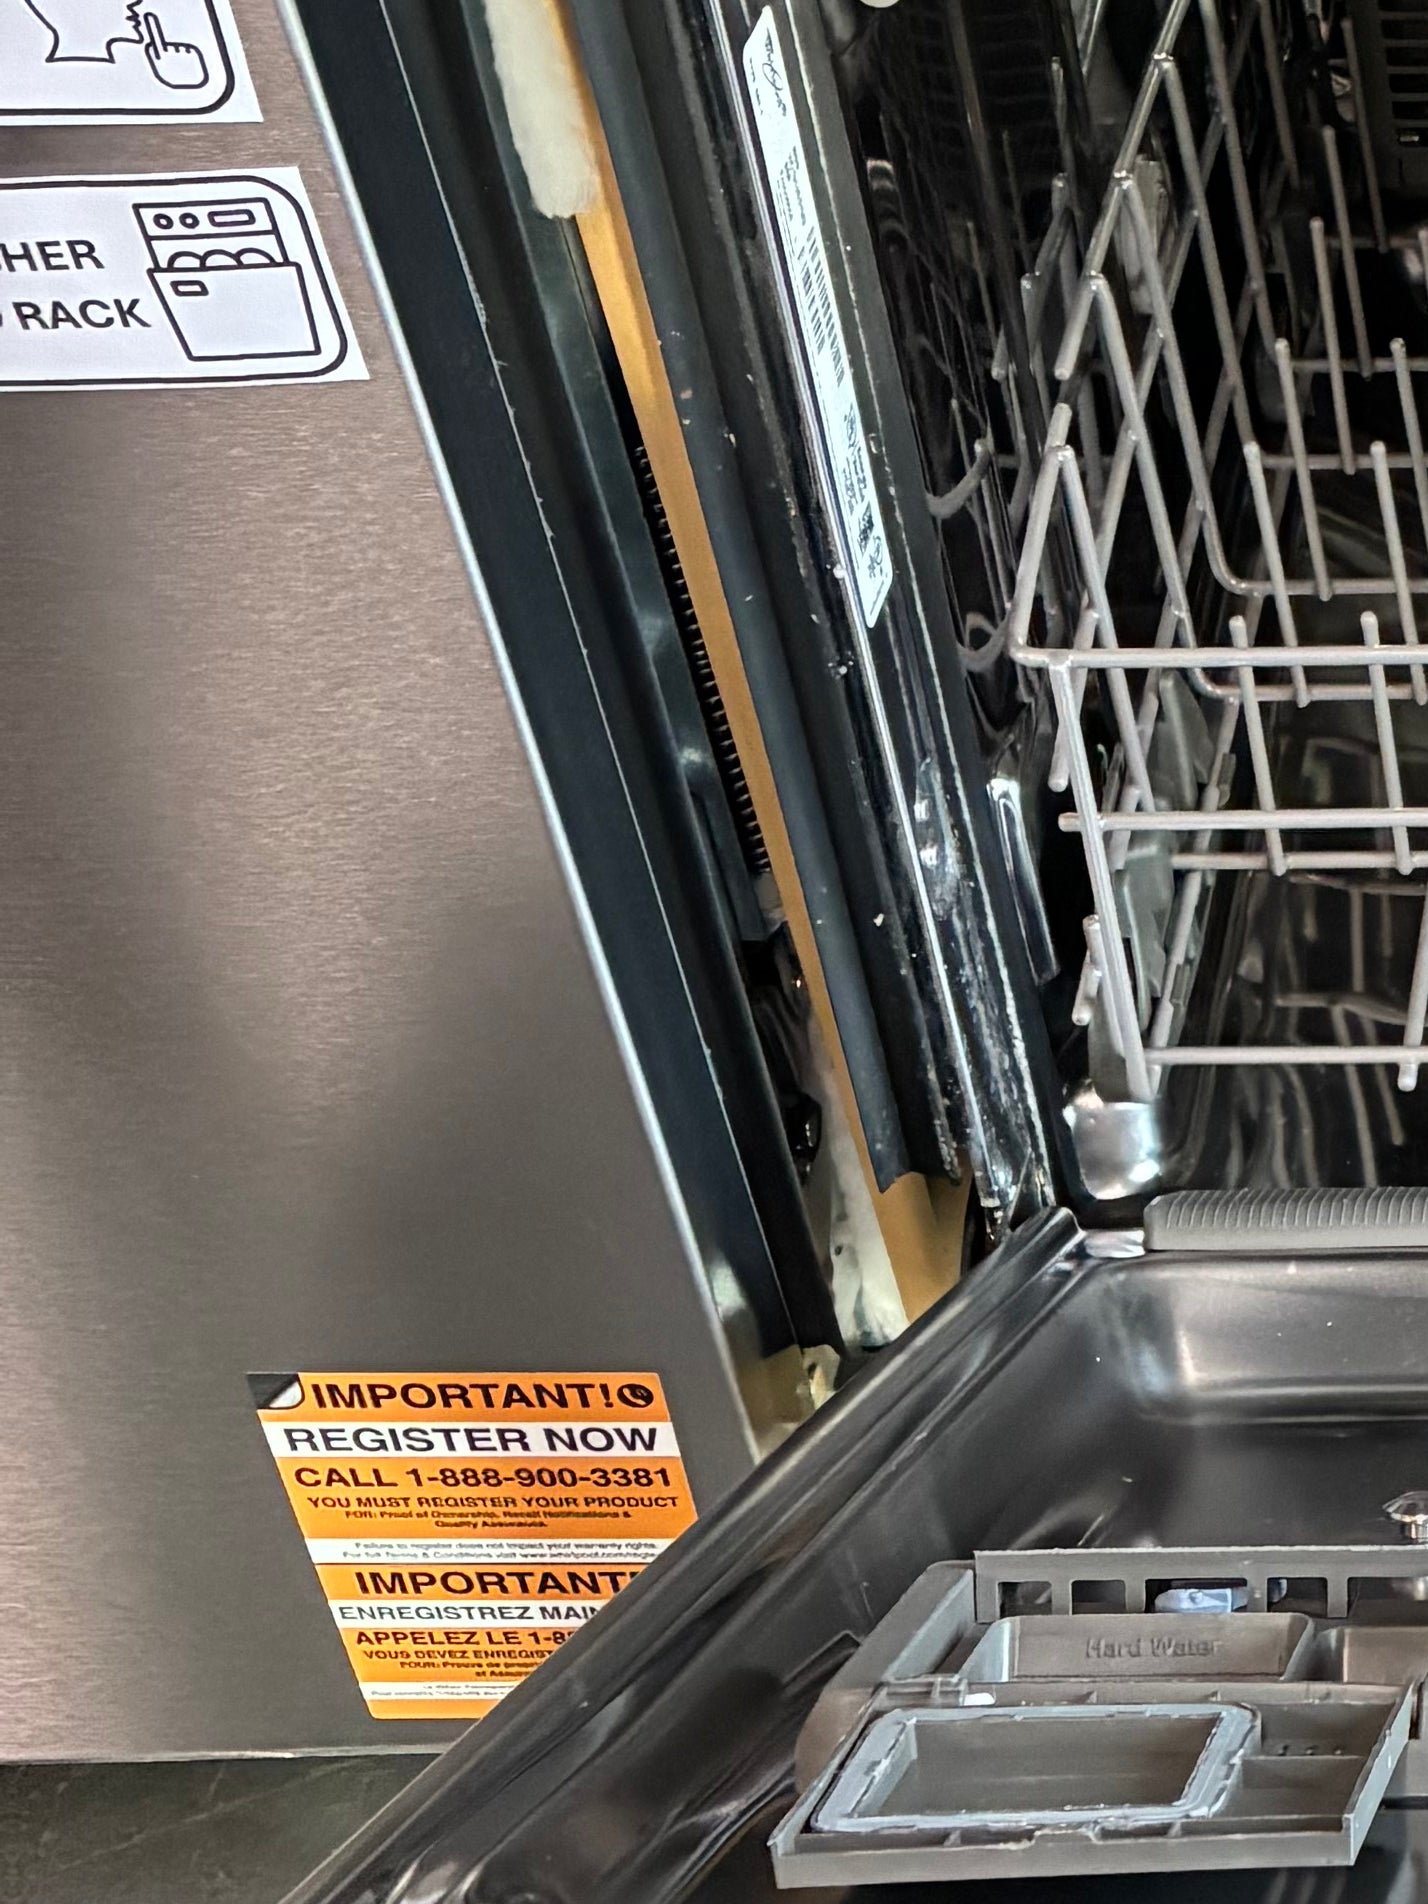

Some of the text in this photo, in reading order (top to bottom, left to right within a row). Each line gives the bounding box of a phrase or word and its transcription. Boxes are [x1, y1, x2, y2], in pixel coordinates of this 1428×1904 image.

[0, 239, 105, 273] HER
[12, 299, 152, 330] RACK
[312, 1383, 613, 1409] IMPORTANT!
[284, 1427, 657, 1452] REGISTER NOW
[294, 1467, 671, 1488] CALL 1-888-900-3381
[307, 1496, 679, 1508] YOU MUST REGISTER YOUR PRODUCT
[339, 1606, 534, 1620] ENREGISTREZ
[356, 1631, 481, 1646] APPELEZ
[486, 1631, 520, 1646] LE
[1086, 1637, 1224, 1658] Hard Water
